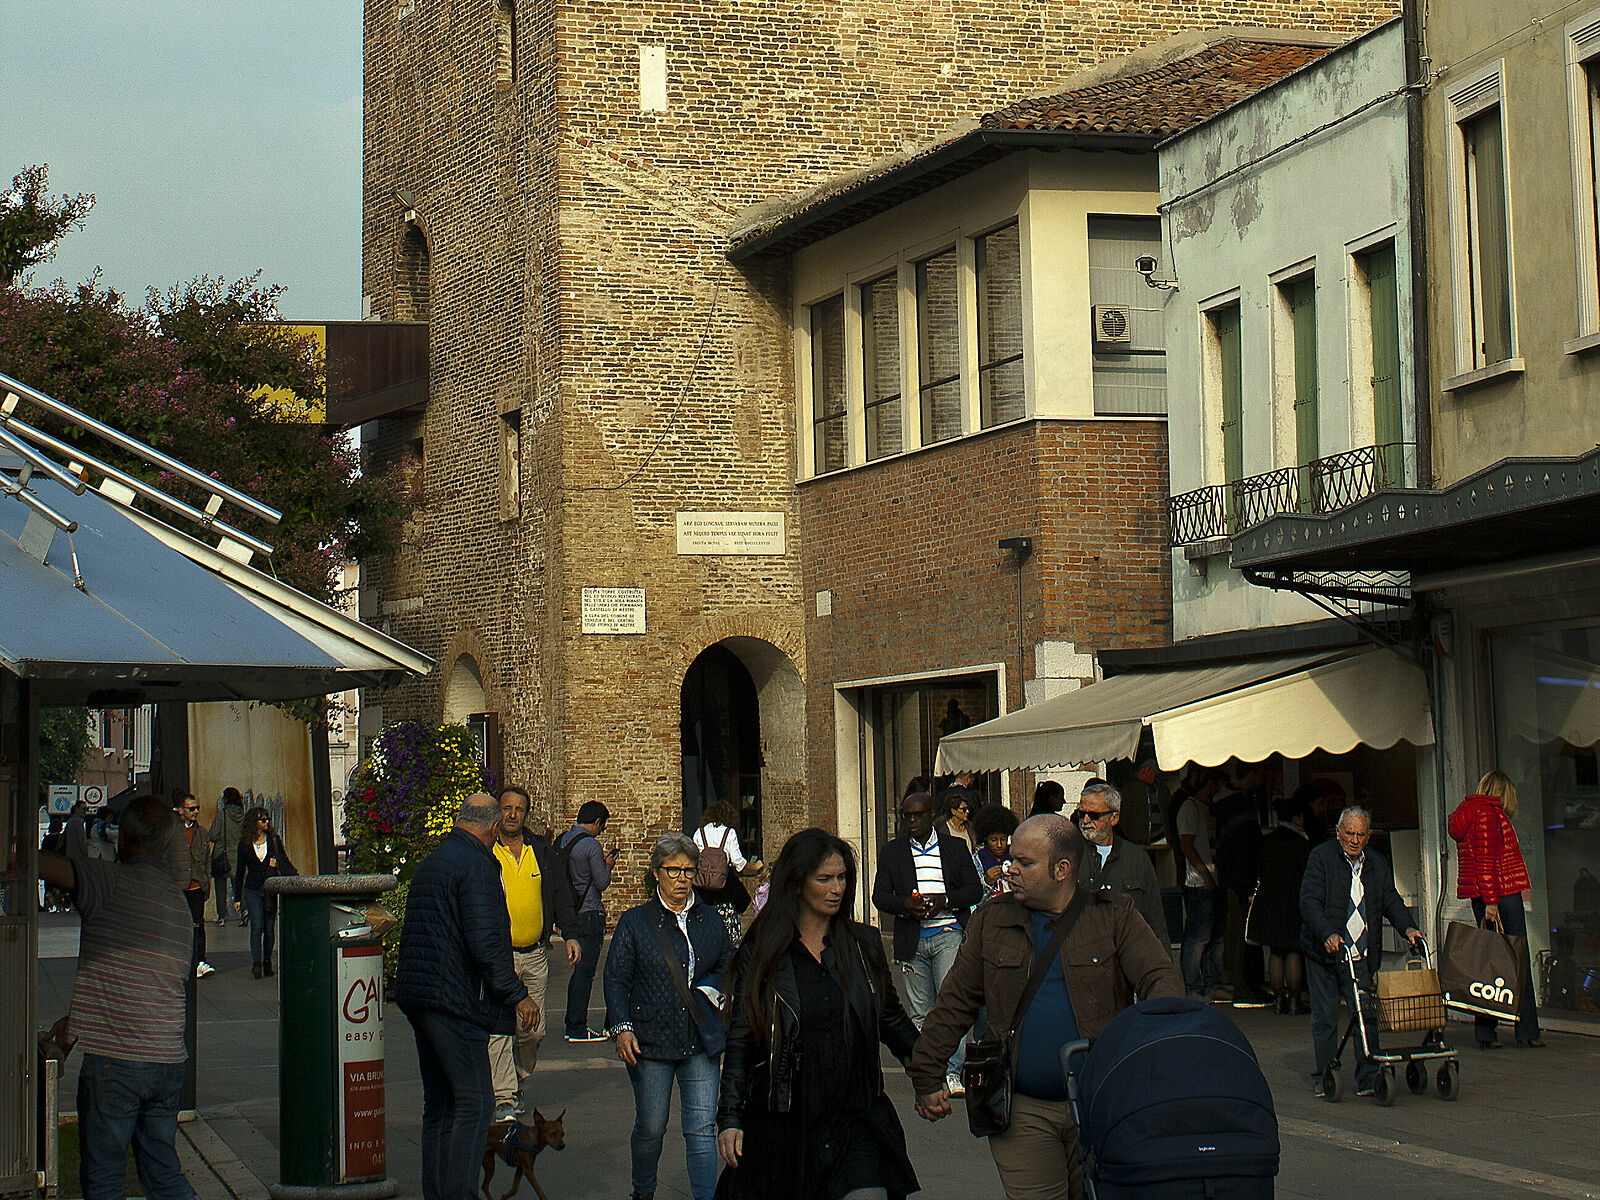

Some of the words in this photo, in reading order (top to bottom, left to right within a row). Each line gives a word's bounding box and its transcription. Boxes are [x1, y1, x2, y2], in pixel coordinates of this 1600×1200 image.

[1469, 977, 1514, 1005] coin
[345, 1031, 375, 1042] easy
[350, 1072, 366, 1082] VIA
[350, 1141, 372, 1150] INFO
